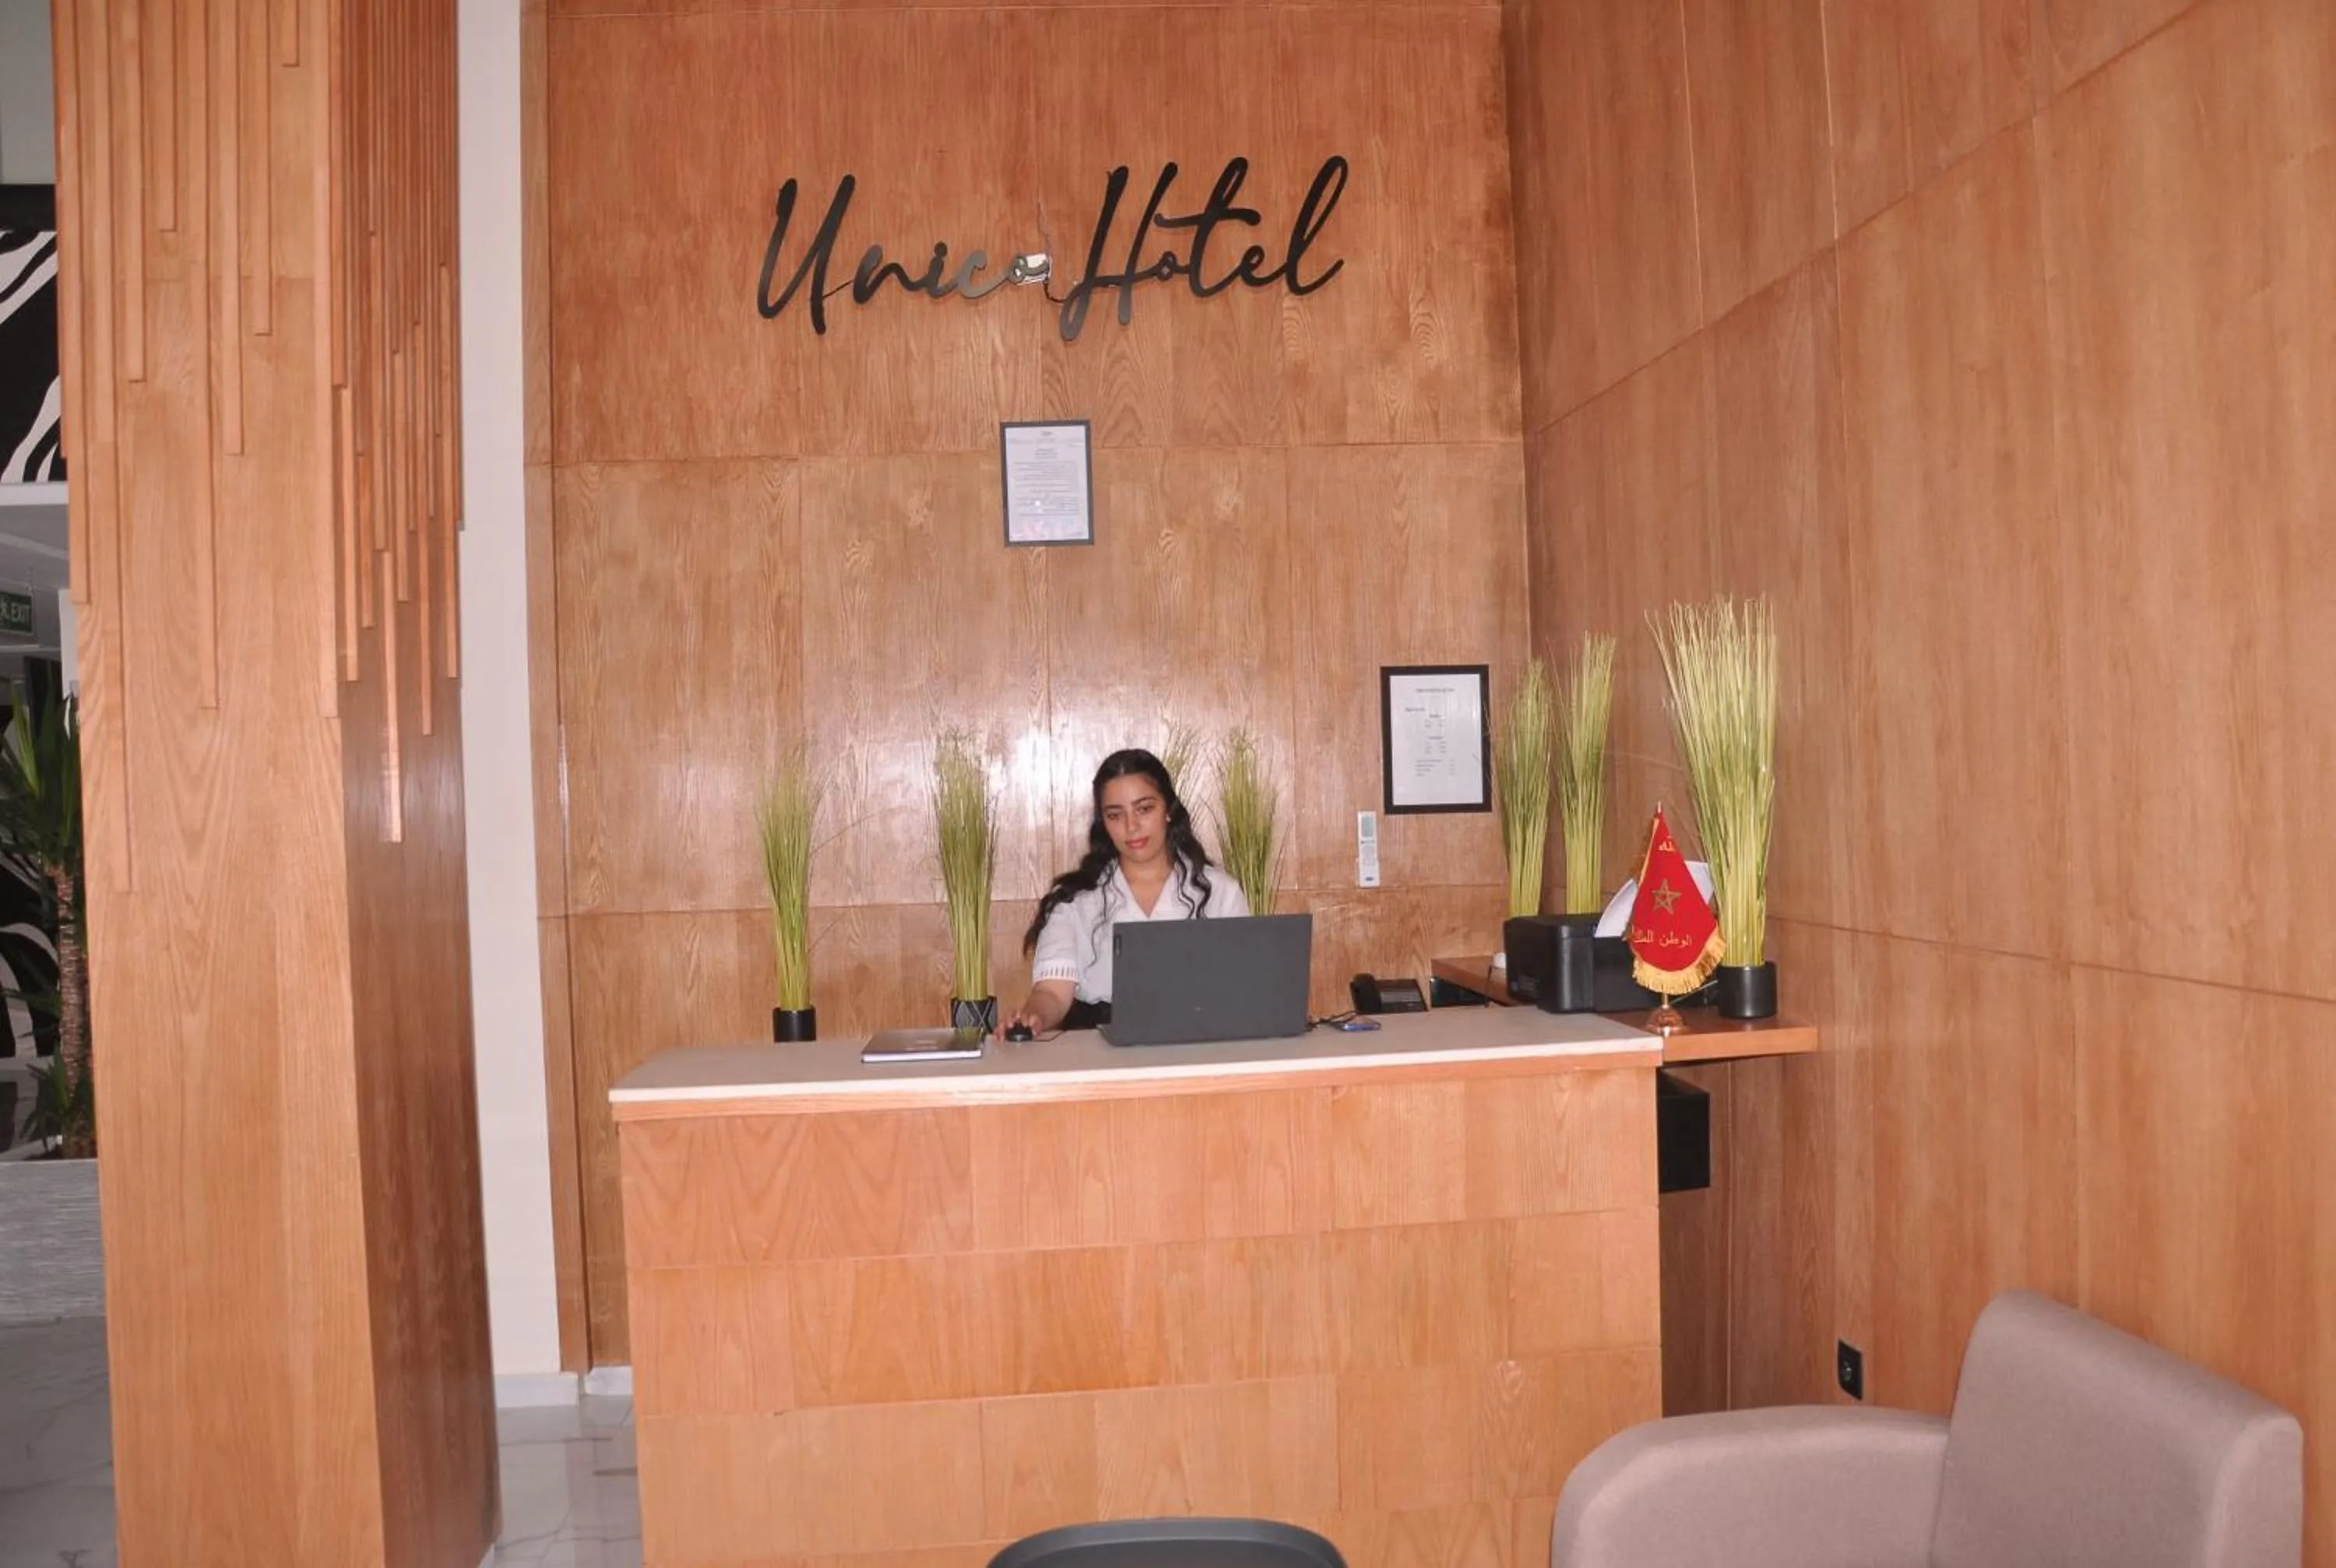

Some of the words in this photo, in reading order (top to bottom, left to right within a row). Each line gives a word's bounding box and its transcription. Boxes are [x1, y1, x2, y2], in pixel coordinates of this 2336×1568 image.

[756, 174, 1051, 335] Unico
[1060, 156, 1349, 341] Hotel
[10, 602, 30, 623] EXIT
